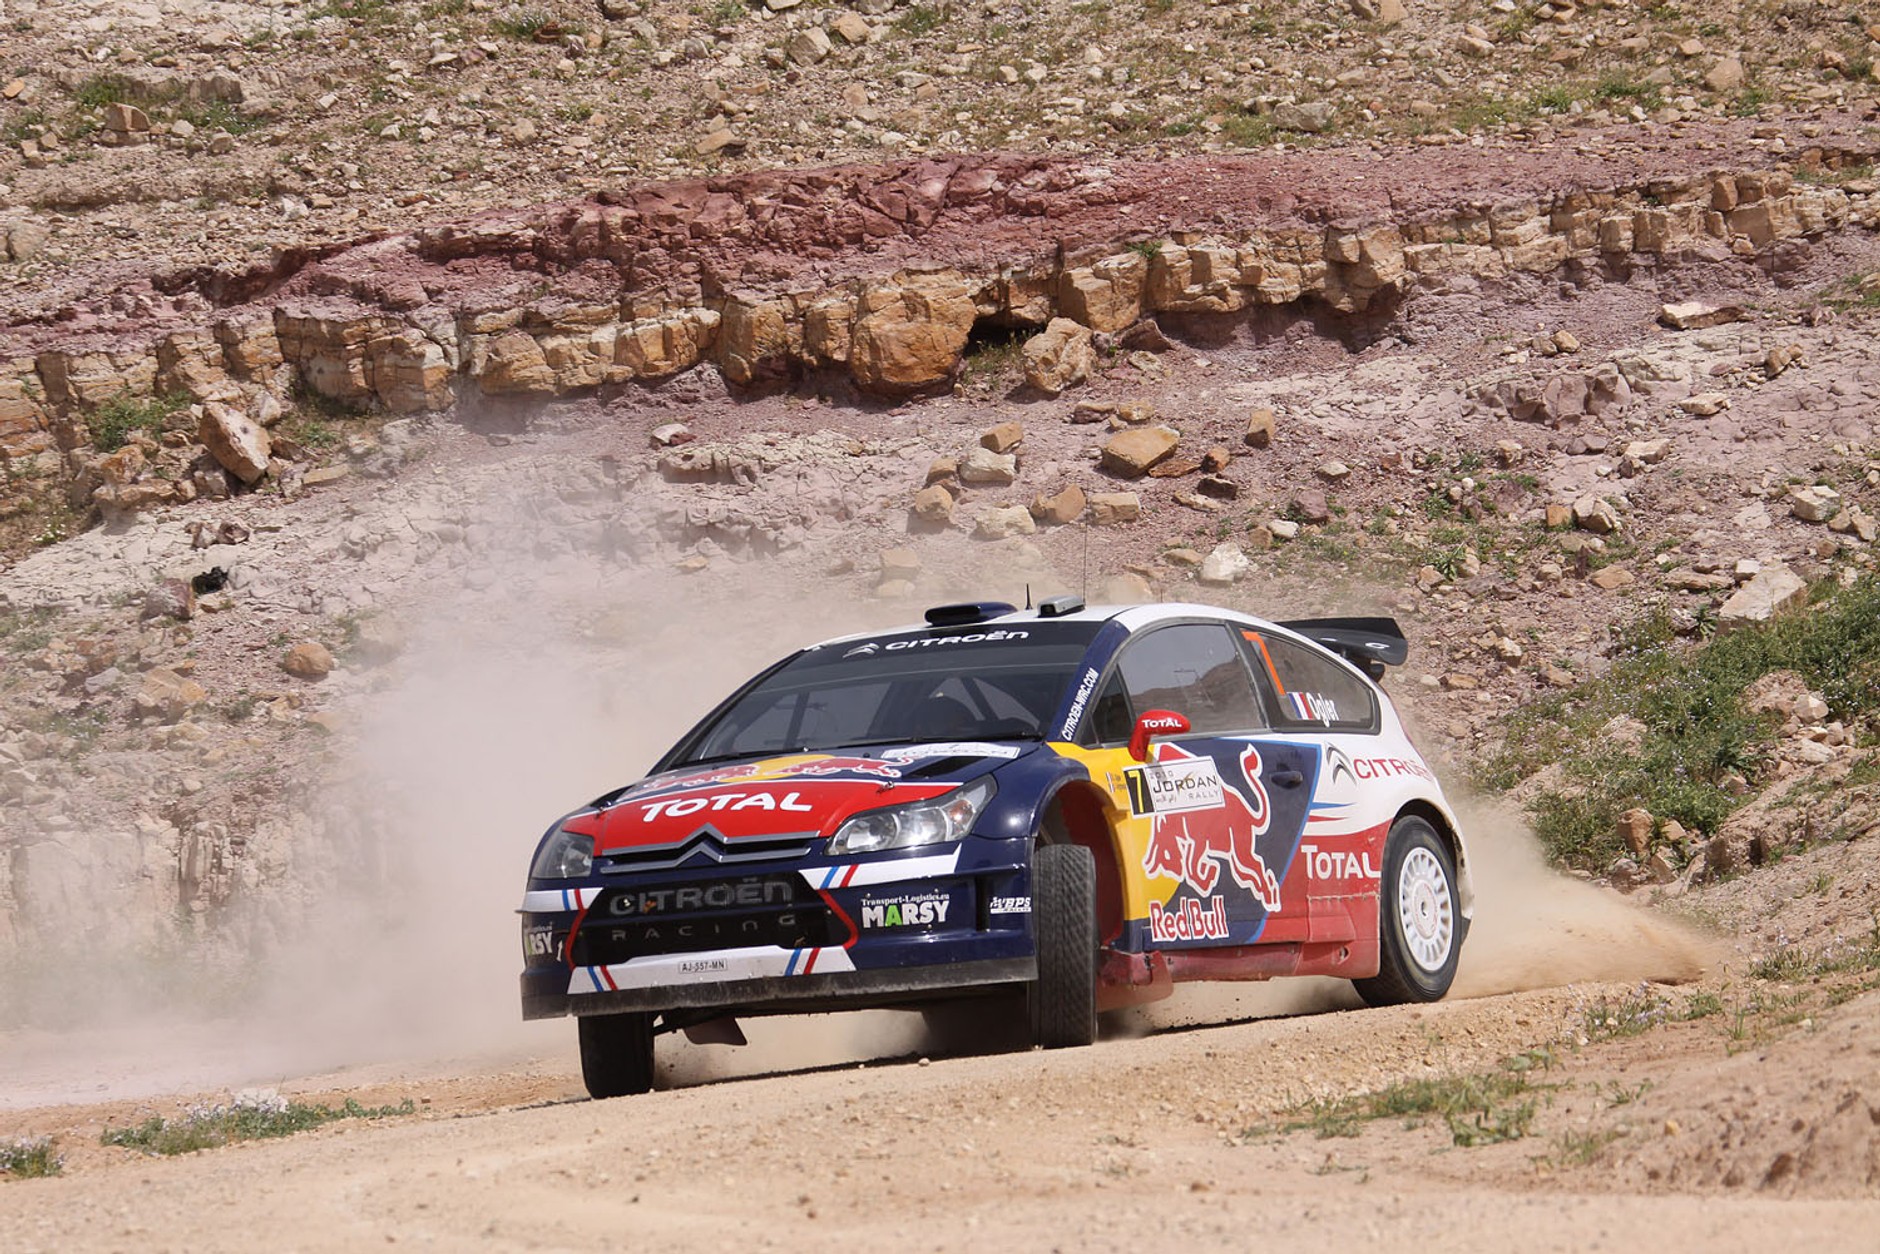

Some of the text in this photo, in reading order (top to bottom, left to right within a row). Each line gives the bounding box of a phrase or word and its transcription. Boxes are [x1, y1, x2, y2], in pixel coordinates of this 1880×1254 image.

[1241, 631, 1287, 696] 7
[1061, 667, 1099, 741] CITROEN-WRC.COM
[1142, 717, 1182, 728] TOTAL
[1127, 769, 1145, 813] 7
[1153, 775, 1218, 793] JORDAN
[1188, 790, 1219, 799] RALLY
[641, 792, 813, 822] TOTAL
[1301, 845, 1381, 879] TOTAL
[612, 914, 795, 941] RACING
[862, 901, 949, 928] MARSY
[1150, 895, 1229, 942] Red Bull
[682, 961, 726, 972] AJ-557-MN
